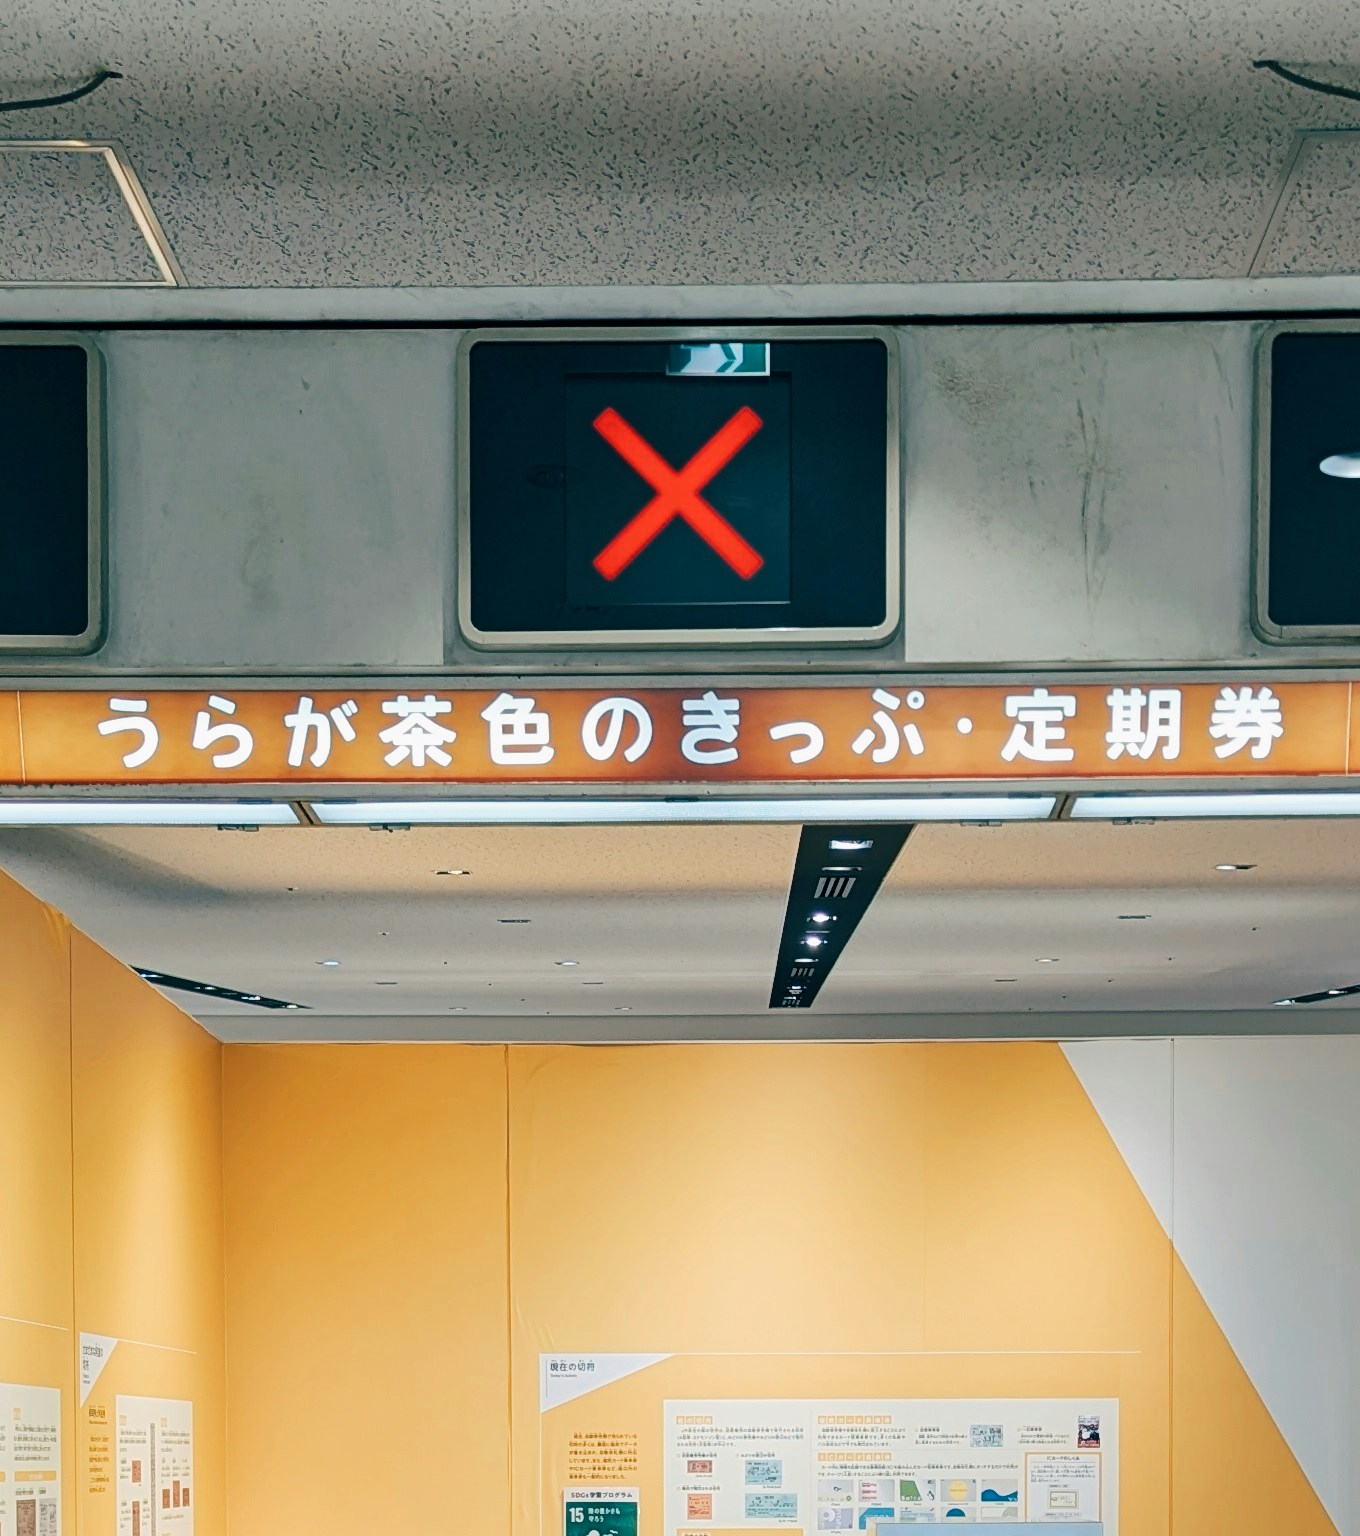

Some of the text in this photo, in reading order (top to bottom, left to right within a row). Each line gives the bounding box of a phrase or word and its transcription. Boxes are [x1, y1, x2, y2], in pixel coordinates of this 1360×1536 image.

[97, 687, 1283, 769] うらが茶色のきっぷ・定期券
[550, 1363, 595, 1372] 現在の切符
[569, 1507, 584, 1523] 15
